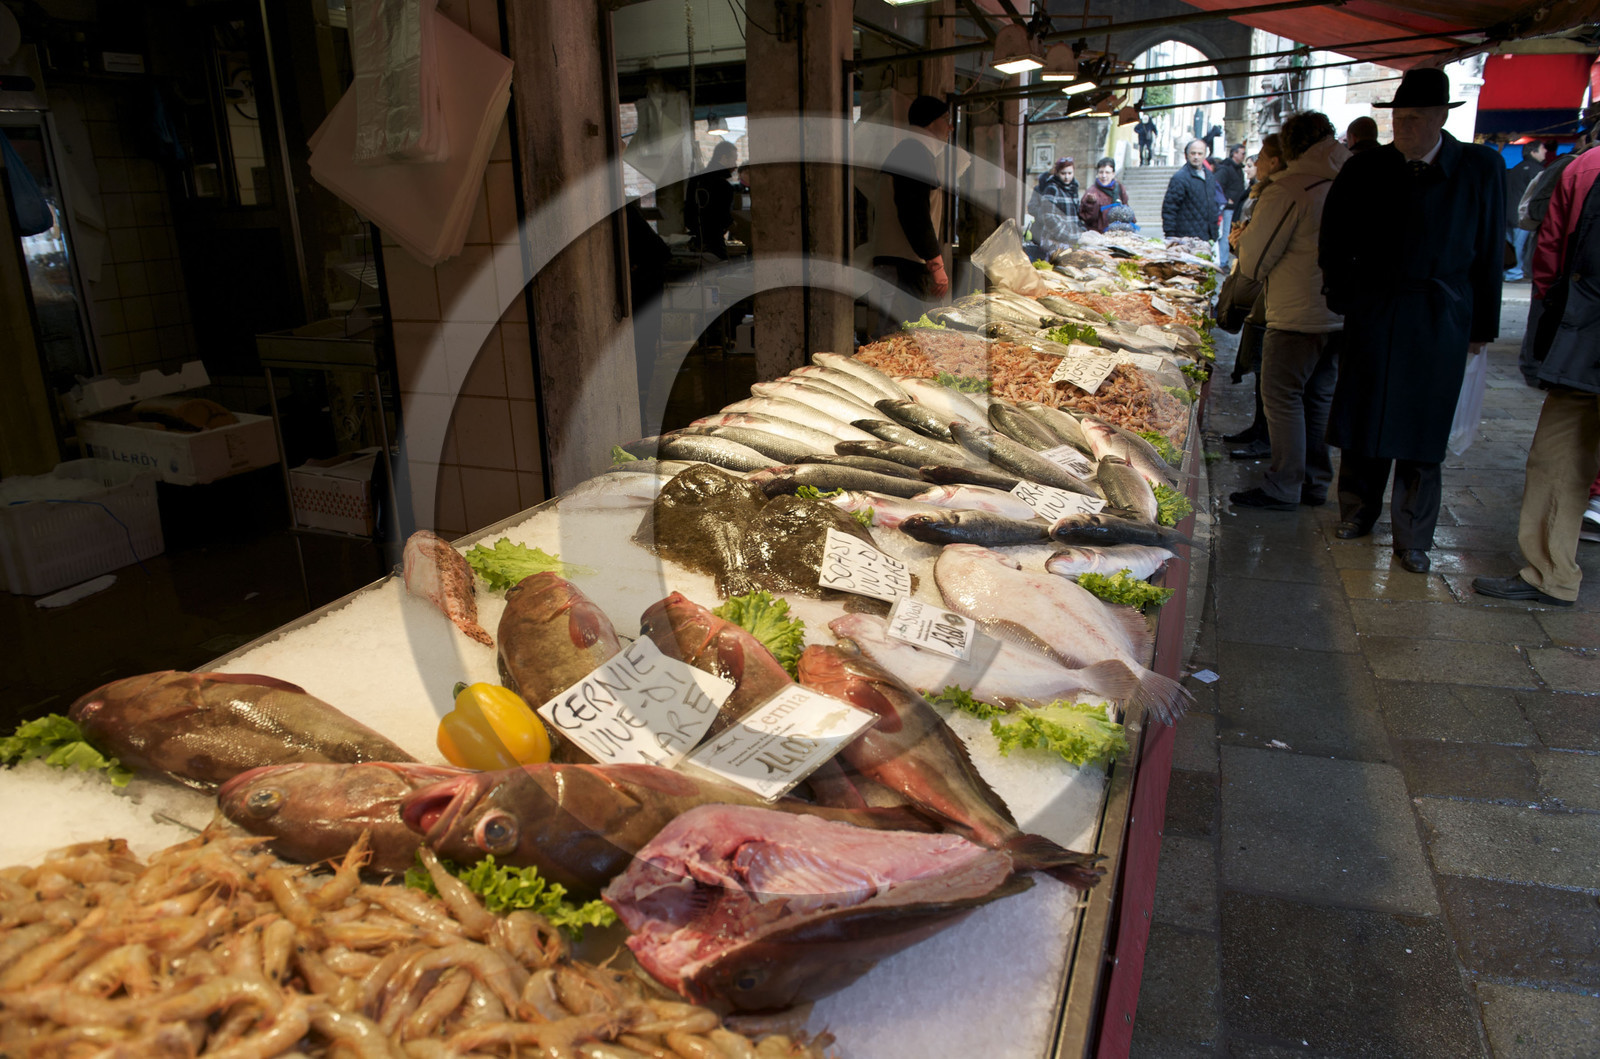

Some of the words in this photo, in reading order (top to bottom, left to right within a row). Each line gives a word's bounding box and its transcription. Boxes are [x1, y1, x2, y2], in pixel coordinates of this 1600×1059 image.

[1016, 482, 1047, 507] BRA
[551, 643, 656, 730] CERNIE
[743, 692, 811, 737] Cernia
